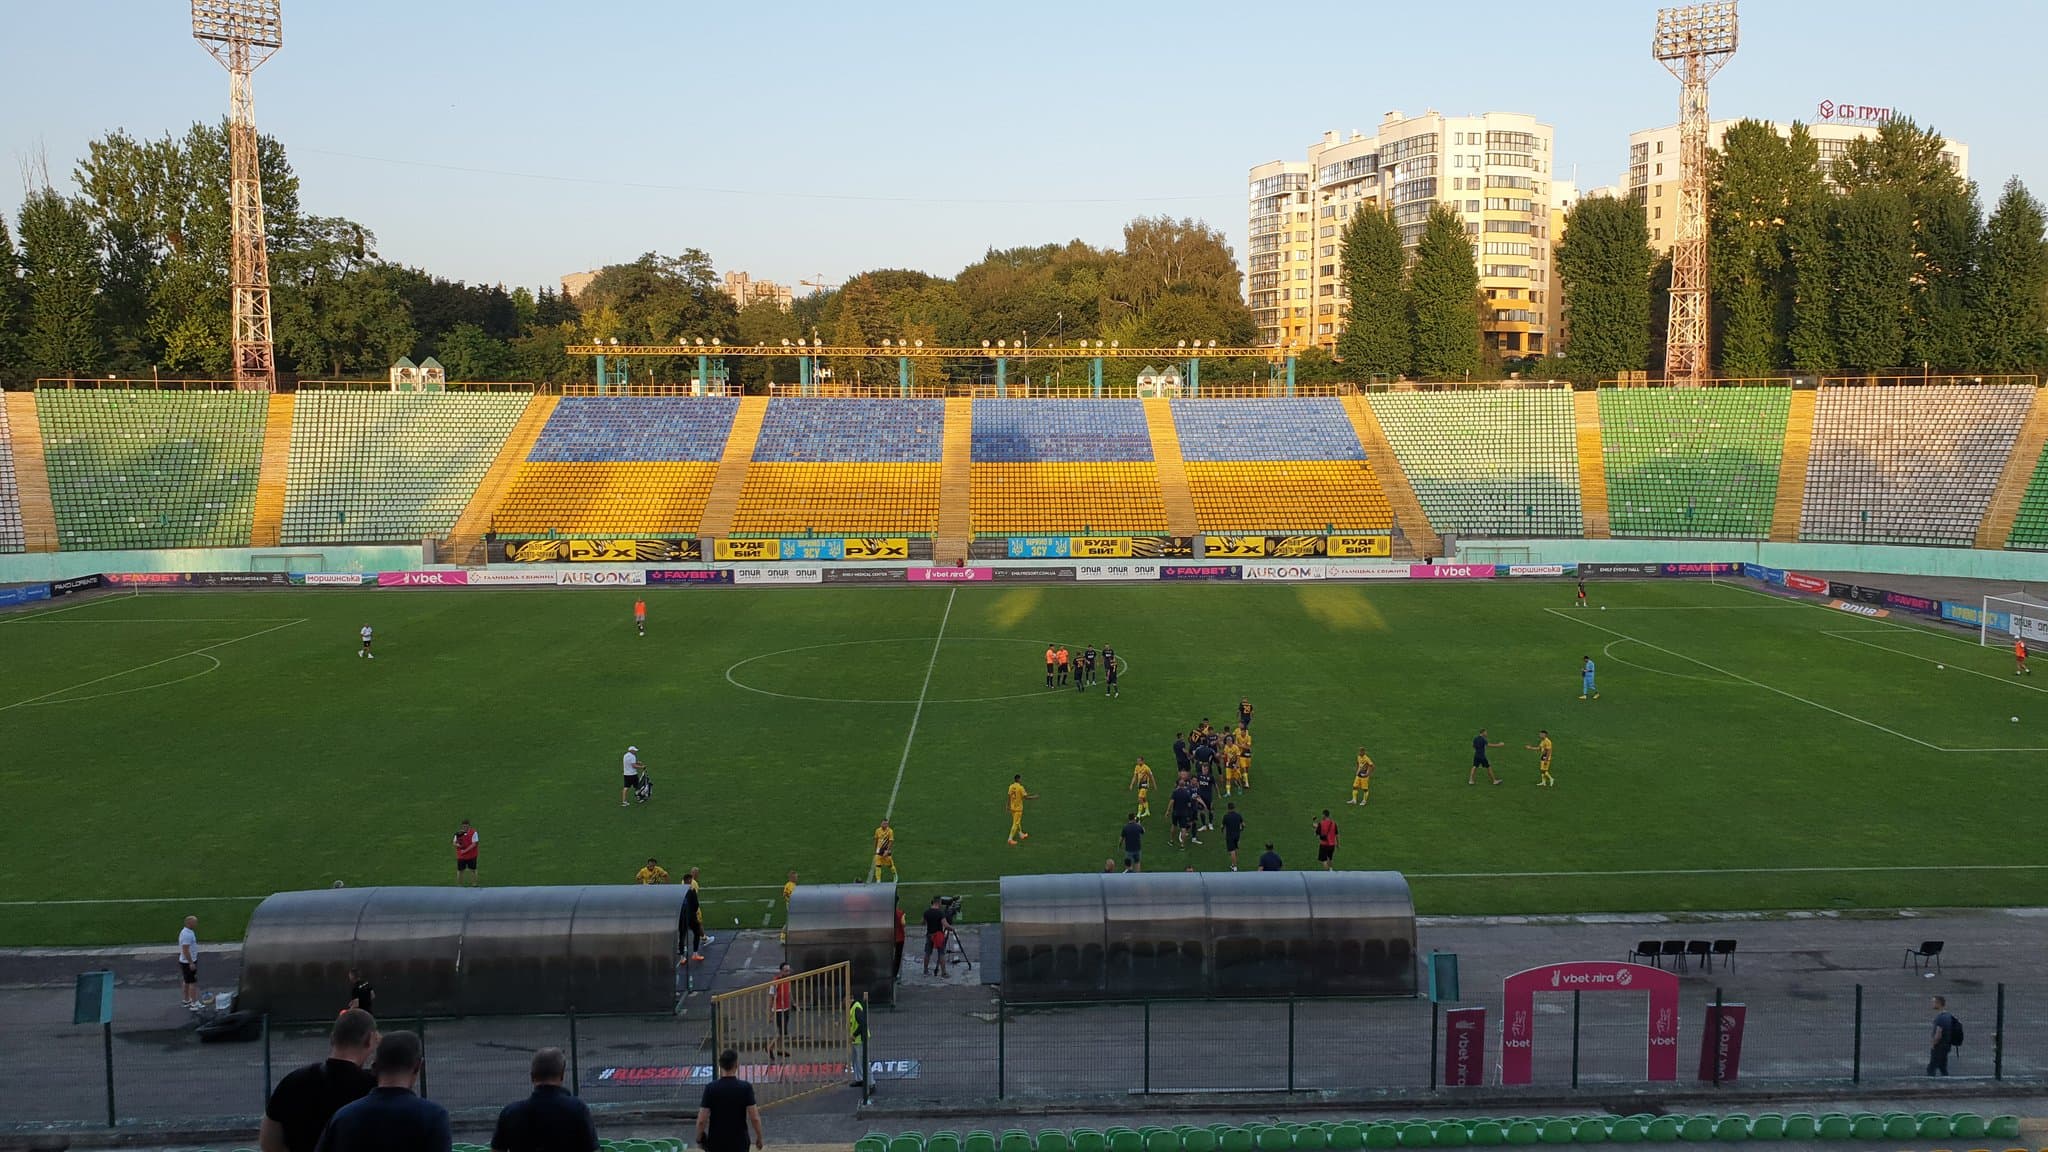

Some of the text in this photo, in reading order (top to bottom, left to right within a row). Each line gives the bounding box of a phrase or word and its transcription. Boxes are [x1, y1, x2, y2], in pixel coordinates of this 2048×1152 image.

[1839, 104, 1889, 121] СБ ГРУП
[1342, 538, 1376, 546] БУДЕ
[572, 549, 632, 558] РУХ
[734, 550, 761, 558] БІЙ!
[846, 548, 905, 556] РУХ
[1205, 546, 1262, 554] РУХ
[1345, 546, 1372, 554] БІЙ!
[1177, 567, 1227, 575] FAVBET
[1247, 567, 1312, 578] AUROOM
[1442, 566, 1471, 576] vbet
[1678, 564, 1728, 572] FAVBET
[122, 574, 180, 582] FAVBET
[412, 572, 444, 584] vbet
[562, 572, 632, 584] AUROOM
[1563, 974, 1590, 983] vbet
[1506, 1039, 1531, 1048] vbet
[1650, 1036, 1676, 1046] vbet
[1458, 1032, 1470, 1061] vbet
